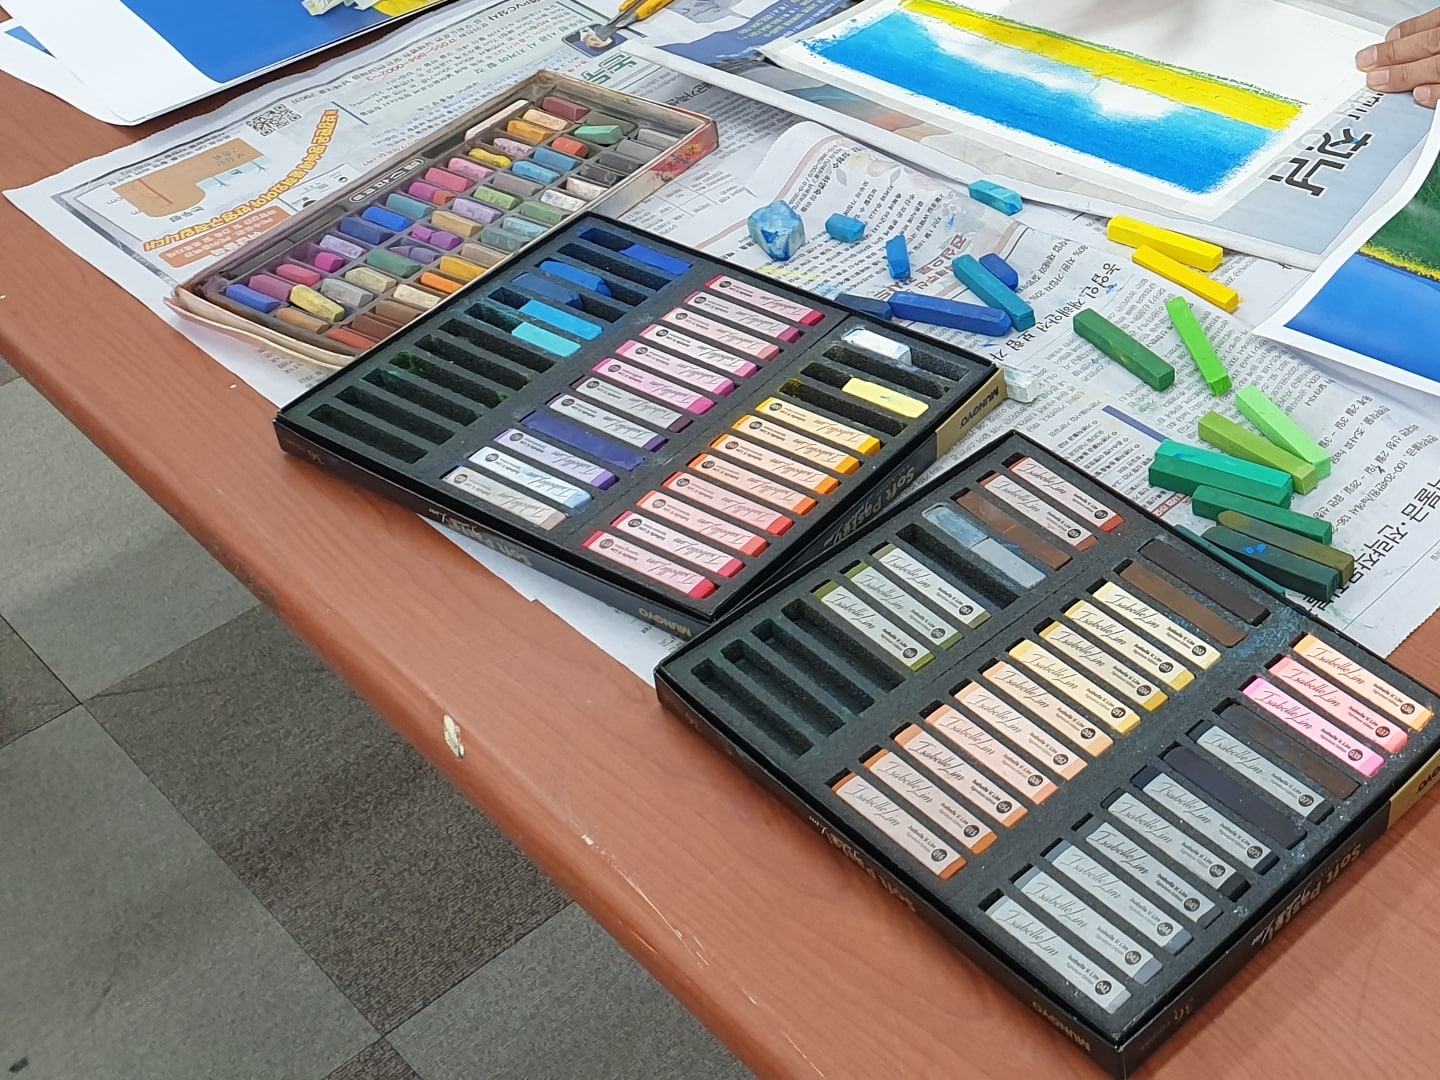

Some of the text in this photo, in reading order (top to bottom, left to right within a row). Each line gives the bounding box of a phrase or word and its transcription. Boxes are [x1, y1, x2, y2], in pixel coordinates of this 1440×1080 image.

[915, 234, 967, 276] 진심으로
[1036, 252, 1057, 274] 재해와
[1042, 272, 1064, 291] 가입자
[1080, 260, 1121, 299] 농업인
[1034, 296, 1086, 333] 재해안전
[1005, 330, 1035, 351] 보험
[960, 386, 1000, 429] MUNGYO
[1345, 404, 1360, 417] 2월
[1334, 416, 1349, 430] 3일
[1343, 426, 1366, 449] 조사료
[1385, 435, 1402, 450] 신청
[1375, 450, 1389, 463] 2월
[1327, 495, 1345, 509] 읍면
[638, 607, 693, 638] MUNGYO
[1376, 726, 1388, 738] 037
[1300, 794, 1312, 806] 077
[1325, 843, 1362, 887] Soft
[1030, 1001, 1092, 1052] MUNGYO
